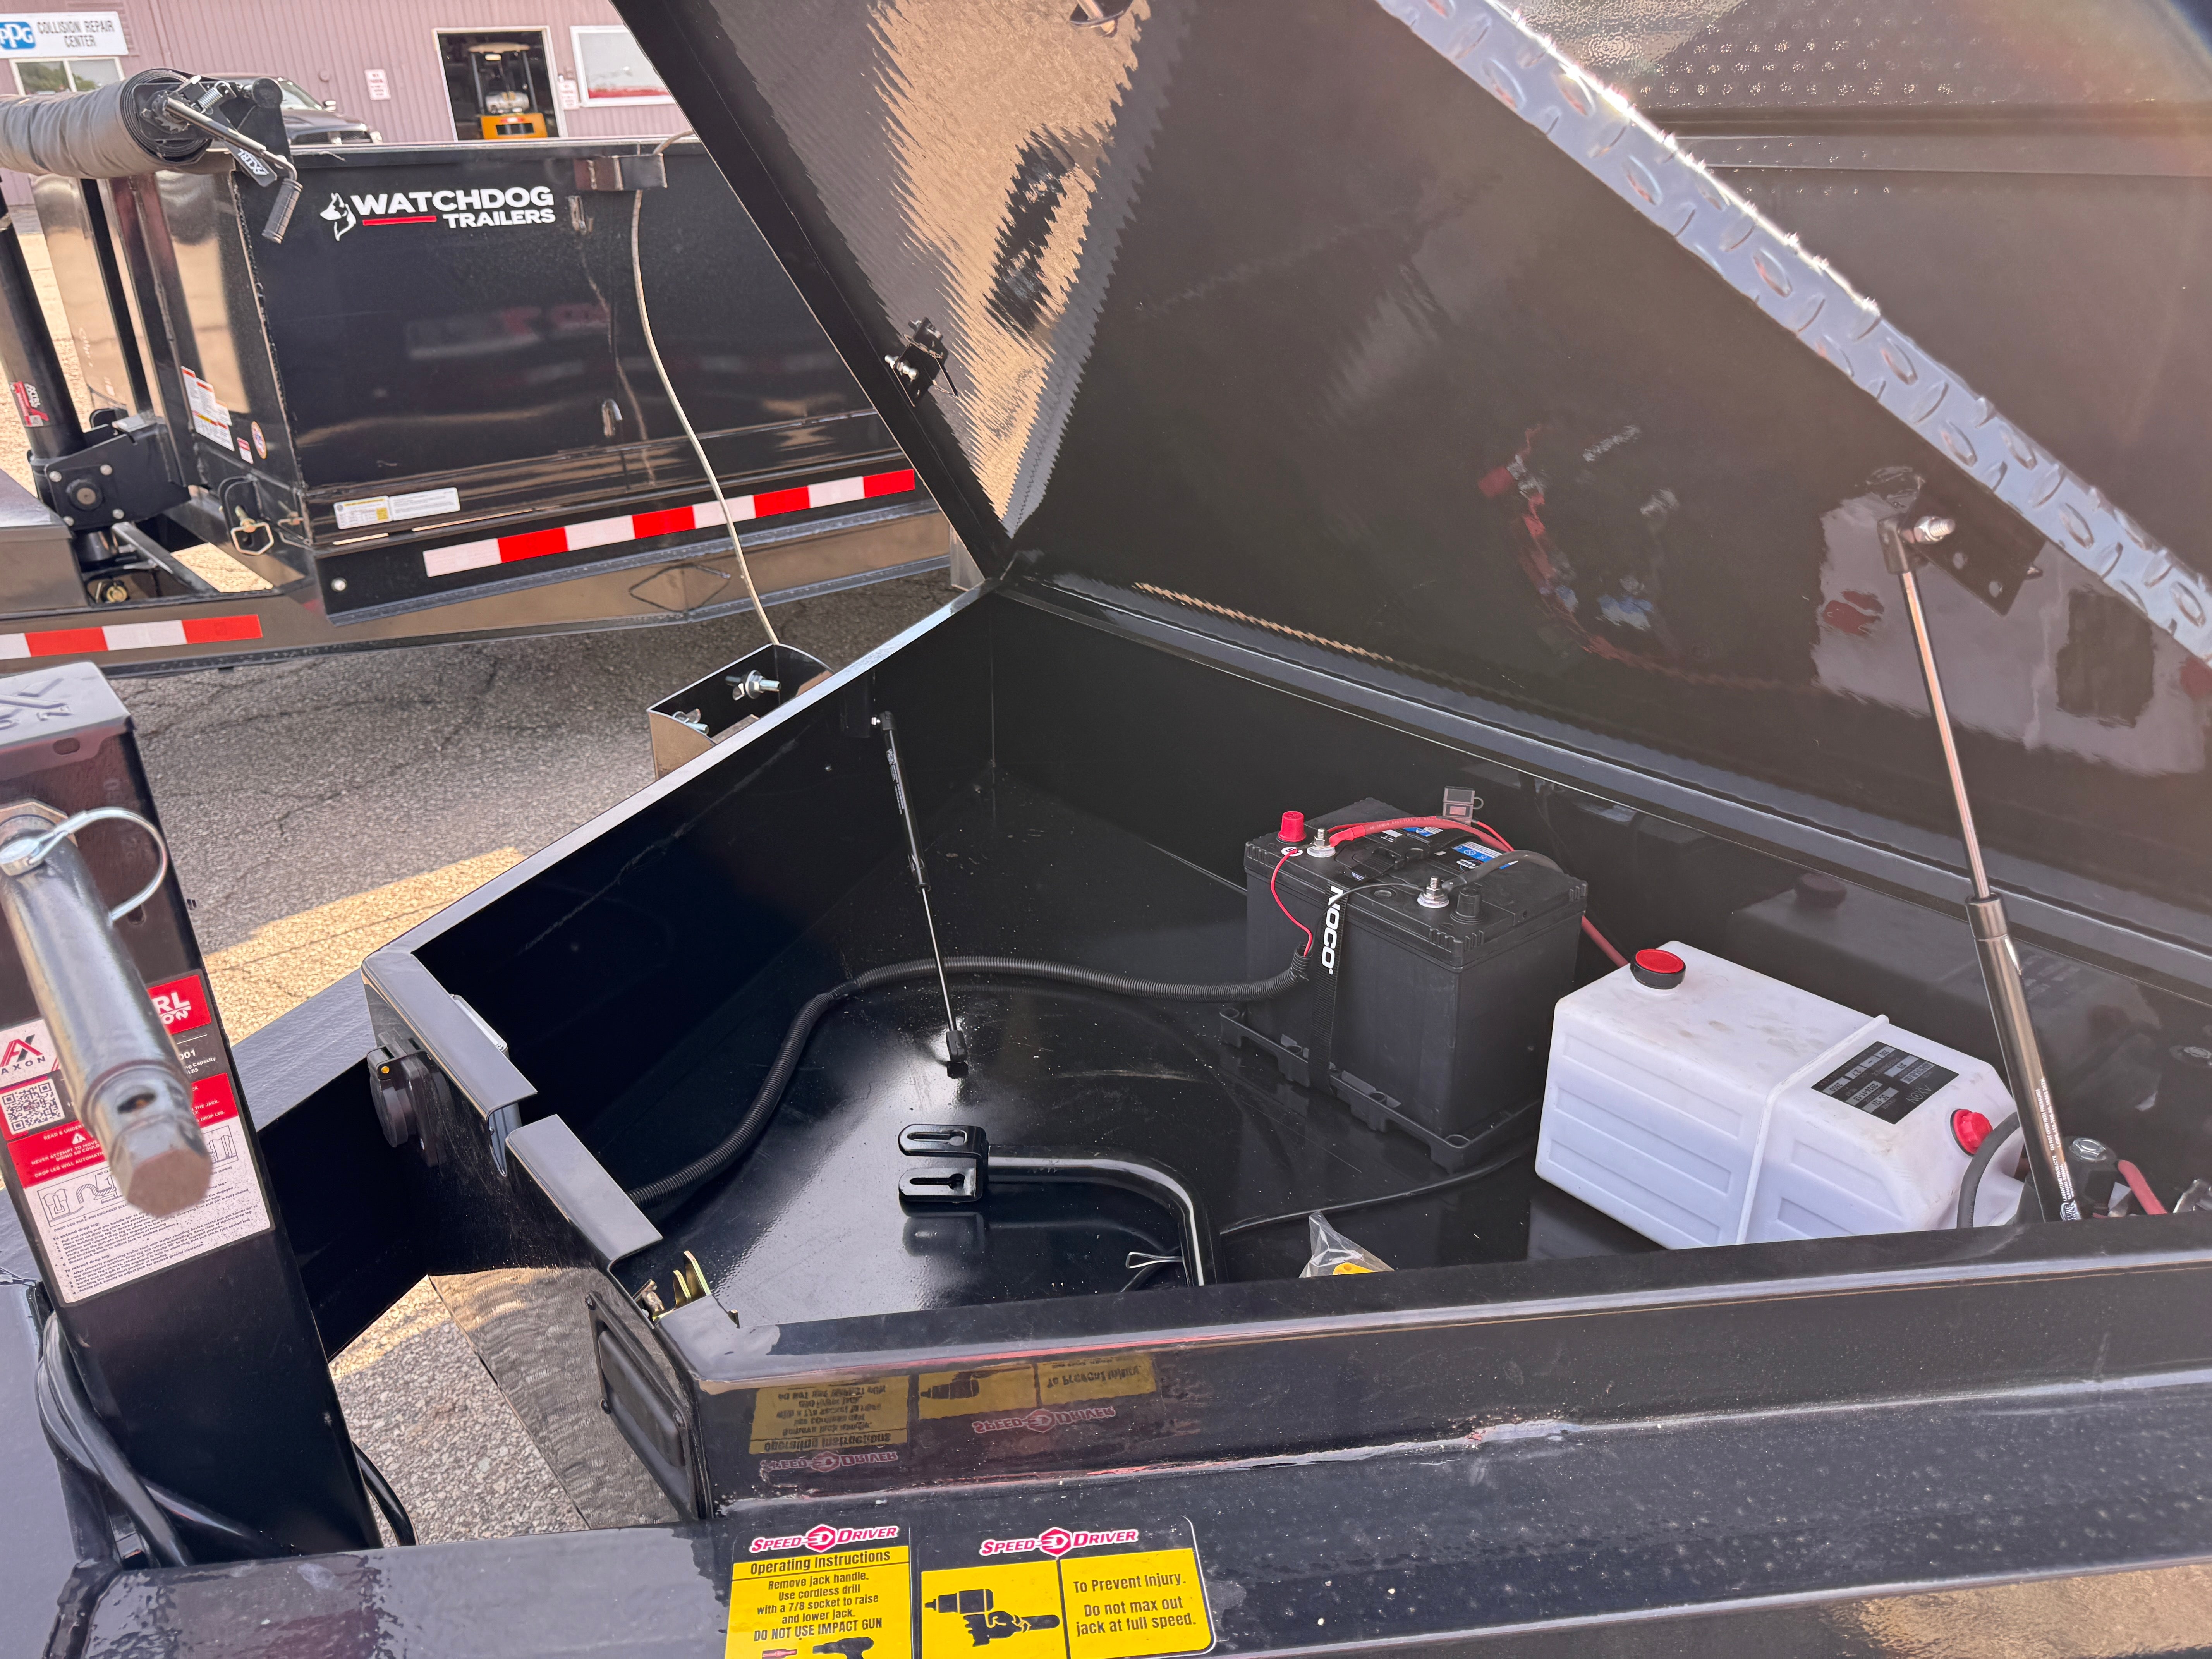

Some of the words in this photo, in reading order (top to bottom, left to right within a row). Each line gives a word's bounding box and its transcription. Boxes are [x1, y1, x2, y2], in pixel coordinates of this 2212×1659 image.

[37, 21, 82, 33] COLLISION
[84, 21, 115, 32] REPAIR
[64, 35, 96, 48] CENTER
[350, 186, 554, 215] WATCHDOG
[442, 208, 556, 228] TRAILERS
[1321, 886, 1344, 971] NOCO
[1, 1056, 45, 1075] AXON
[192, 1056, 216, 1067] Capacity
[43, 1132, 58, 1140] READ
[64, 1123, 84, 1133] UNDER
[31, 1156, 49, 1165] NEVER
[50, 1148, 73, 1159] ATTEMPT
[82, 1140, 99, 1148] MOVE
[55, 1152, 73, 1161] DOING
[82, 1143, 100, 1152] COULD
[34, 1170, 50, 1178] DROP
[60, 1230, 77, 1238] extend
[71, 1262, 88, 1270] retract
[750, 1534, 803, 1553] SPEED
[836, 1523, 899, 1544] DRIVER
[981, 1537, 1036, 1556] SPEED
[1072, 1527, 1138, 1547] DRIVER
[750, 1558, 811, 1577] Operating
[814, 1549, 891, 1568] Instructions
[768, 1577, 806, 1590] Remove
[808, 1575, 830, 1587] jack
[833, 1570, 869, 1583] handle.
[1073, 1580, 1088, 1594] To
[1092, 1575, 1142, 1593] Prevent
[1144, 1571, 1187, 1589] Injury.
[778, 1591, 795, 1601] Use
[798, 1586, 840, 1599] cordless
[842, 1583, 860, 1594] drill
[756, 1604, 778, 1615] with
[788, 1601, 805, 1611] 7/8
[807, 1598, 840, 1609] socket
[842, 1597, 852, 1606] to
[854, 1594, 879, 1604] raise
[1084, 1604, 1099, 1618] Do
[1104, 1601, 1127, 1616] not
[1130, 1599, 1158, 1614] max
[1161, 1596, 1183, 1611] out
[781, 1614, 800, 1624] and
[802, 1611, 830, 1622] lower
[831, 1608, 855, 1620] jack.
[1075, 1620, 1106, 1637] jack
[1108, 1619, 1123, 1633] at
[1126, 1616, 1148, 1632] full
[1151, 1612, 1197, 1630] speed.
[753, 1630, 768, 1642] DO
[770, 1627, 792, 1640] NOT
[793, 1625, 815, 1637] USE
[817, 1620, 859, 1635] IMPACT
[861, 1618, 883, 1630] GUN
